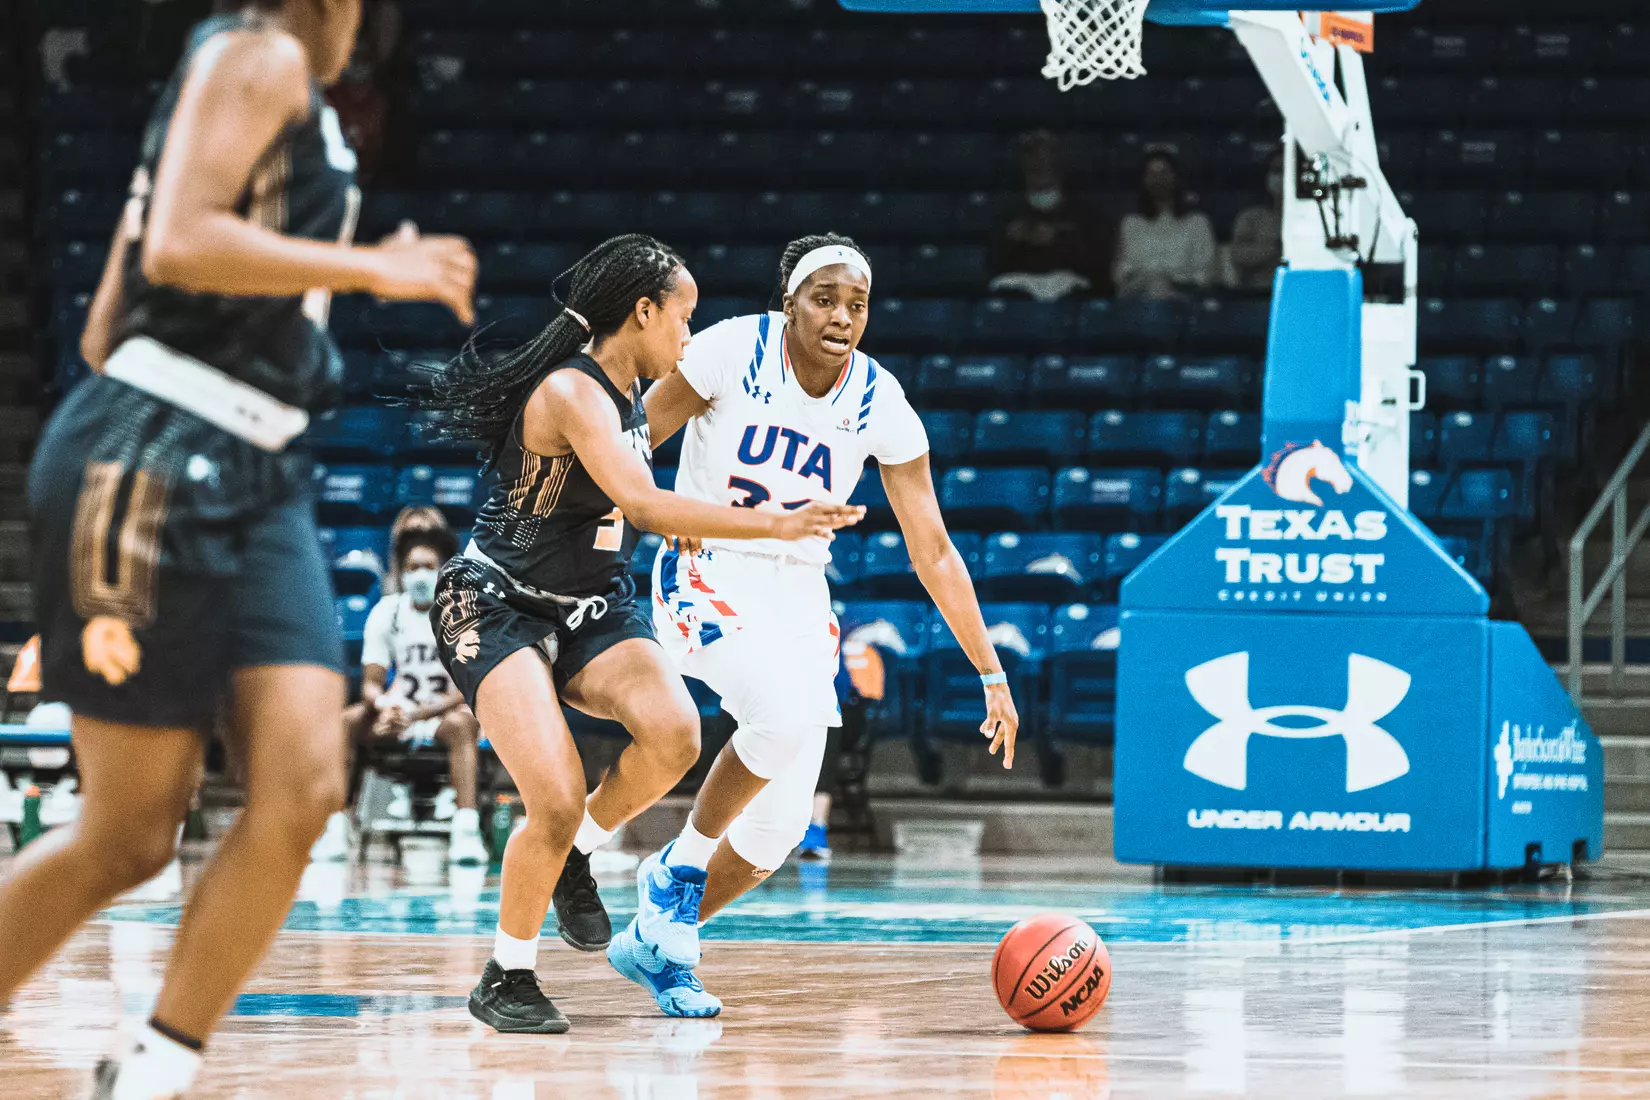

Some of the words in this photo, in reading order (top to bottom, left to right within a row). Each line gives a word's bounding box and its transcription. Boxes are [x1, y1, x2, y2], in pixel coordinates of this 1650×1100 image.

[737, 425, 832, 493] UTA
[1215, 504, 1388, 540] TEXAS
[1215, 547, 1385, 584] TRUST
[1187, 808, 1283, 829] UNDER
[1288, 811, 1411, 832] ARMOUR
[1024, 939, 1089, 999] Wilson
[1060, 964, 1104, 1016] NCAA
